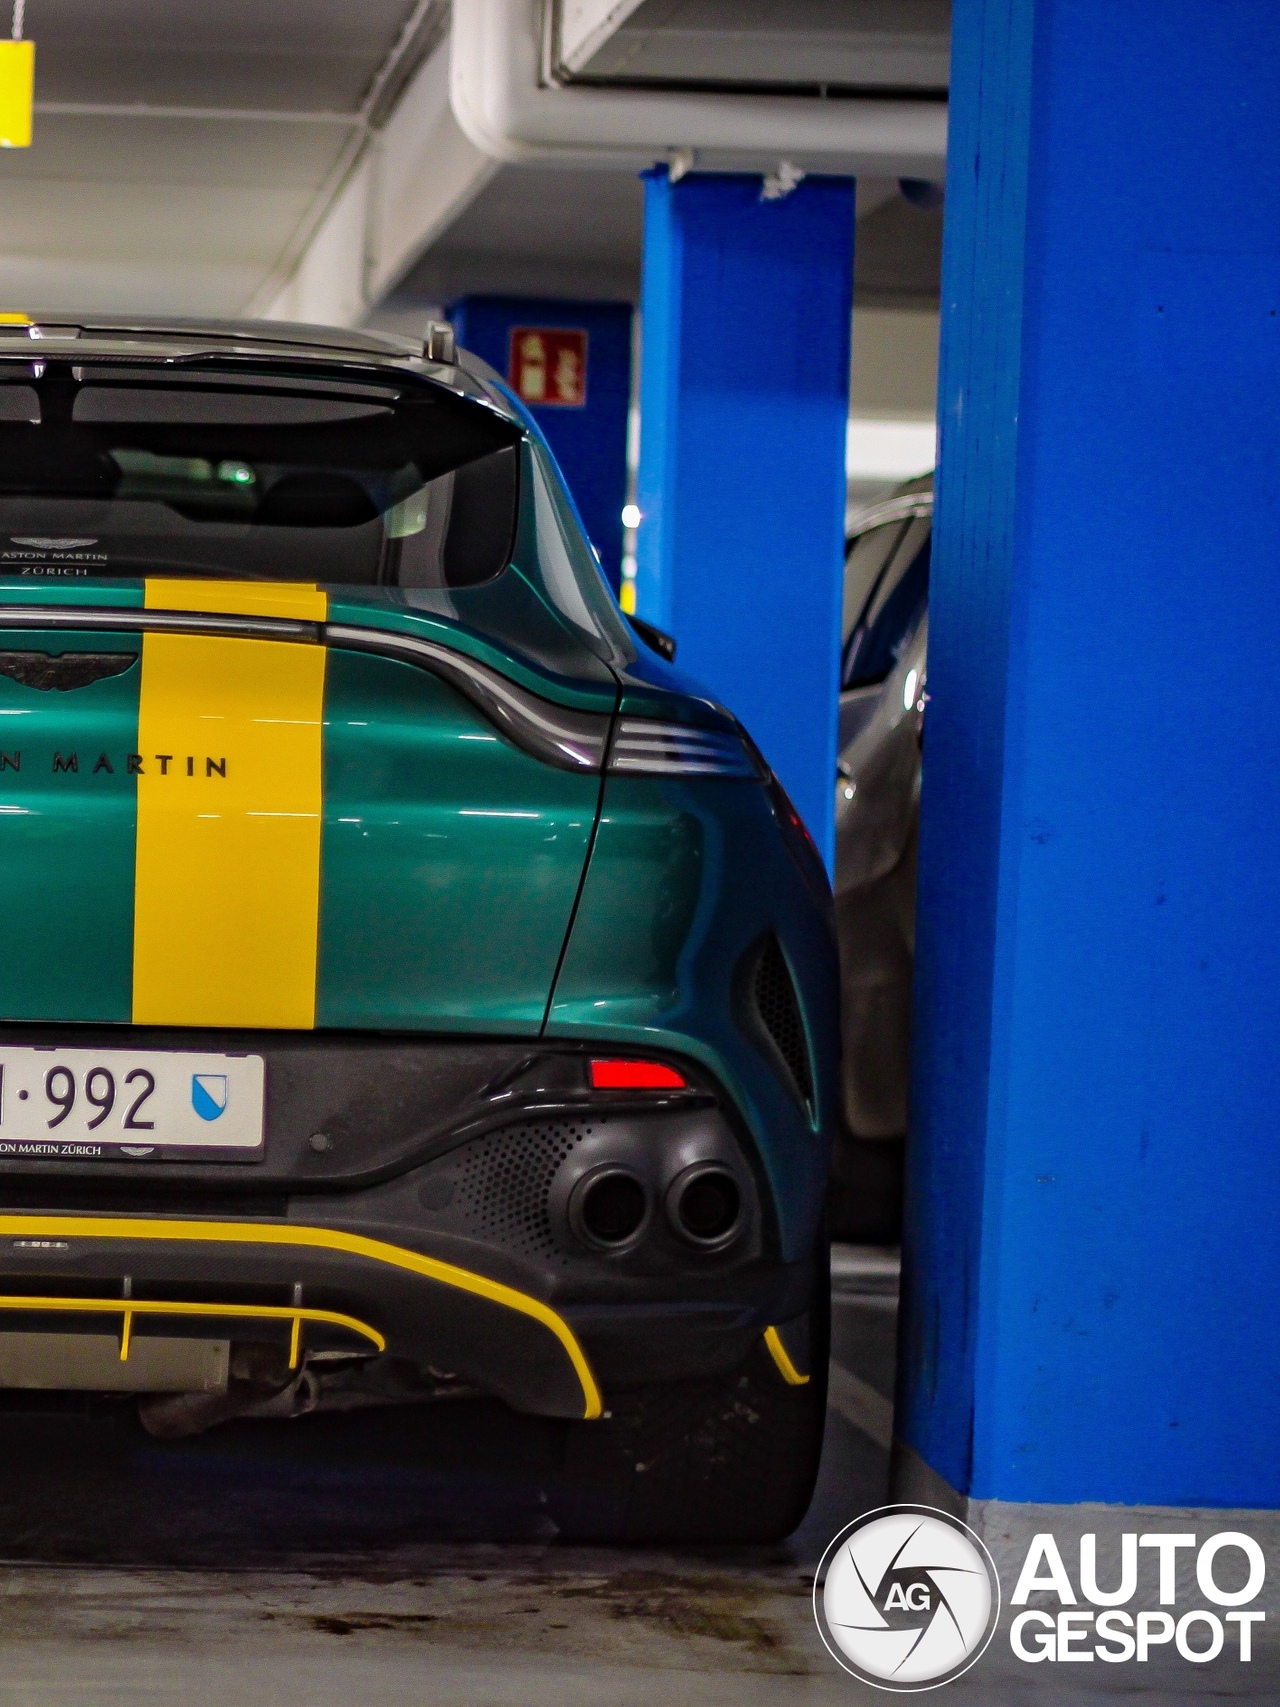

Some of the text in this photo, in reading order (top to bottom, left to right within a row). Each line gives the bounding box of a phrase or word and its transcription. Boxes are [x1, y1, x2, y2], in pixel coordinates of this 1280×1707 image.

[52, 553, 108, 561] MARTIN
[21, 566, 88, 576] ZÜRICH
[53, 752, 227, 778] MARTIN
[18, 1144, 59, 1154] MARTIN
[61, 1144, 101, 1155] ZÜRICH
